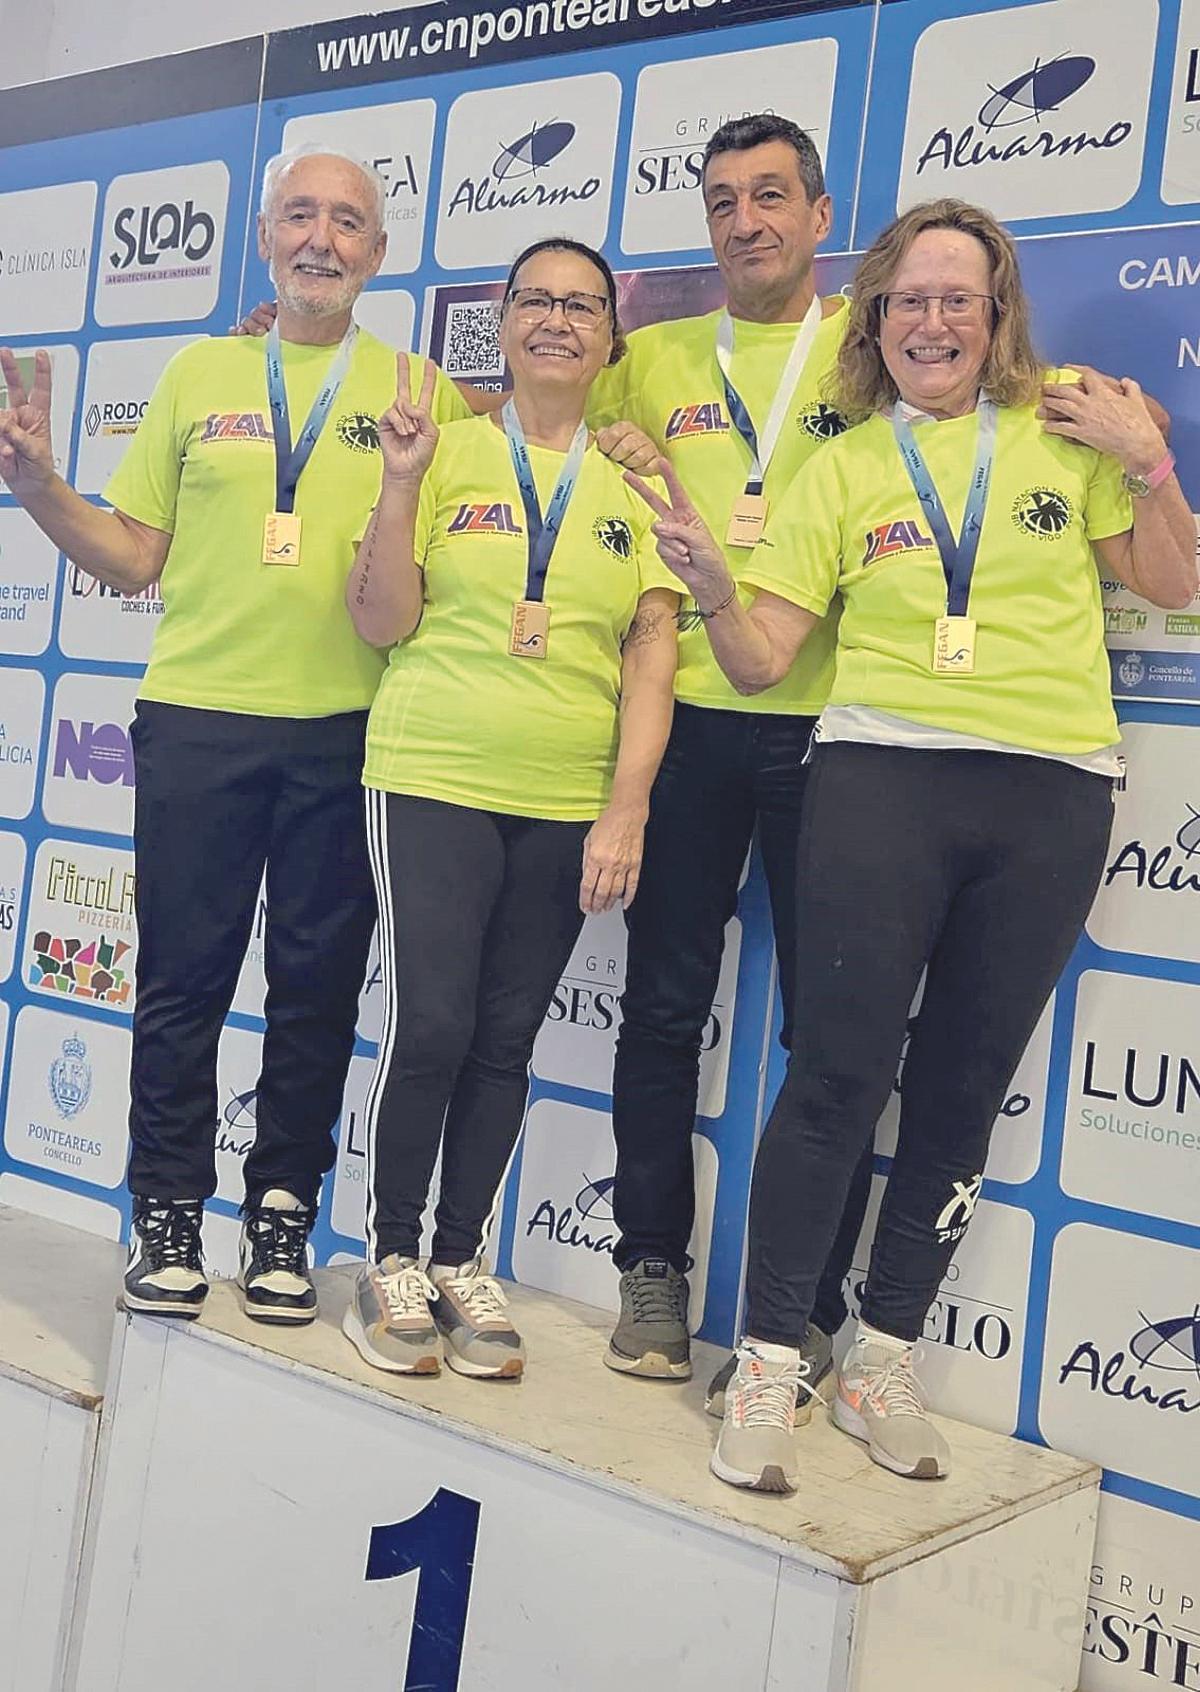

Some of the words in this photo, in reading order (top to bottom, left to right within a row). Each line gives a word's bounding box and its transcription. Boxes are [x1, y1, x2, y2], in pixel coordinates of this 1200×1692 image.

[665, 402, 730, 439] UZAL
[447, 502, 524, 533] UZAL
[13, 583, 50, 601] travel
[27, 1123, 102, 1157] PONTEAREAS
[365, 1487, 481, 1692] 1
